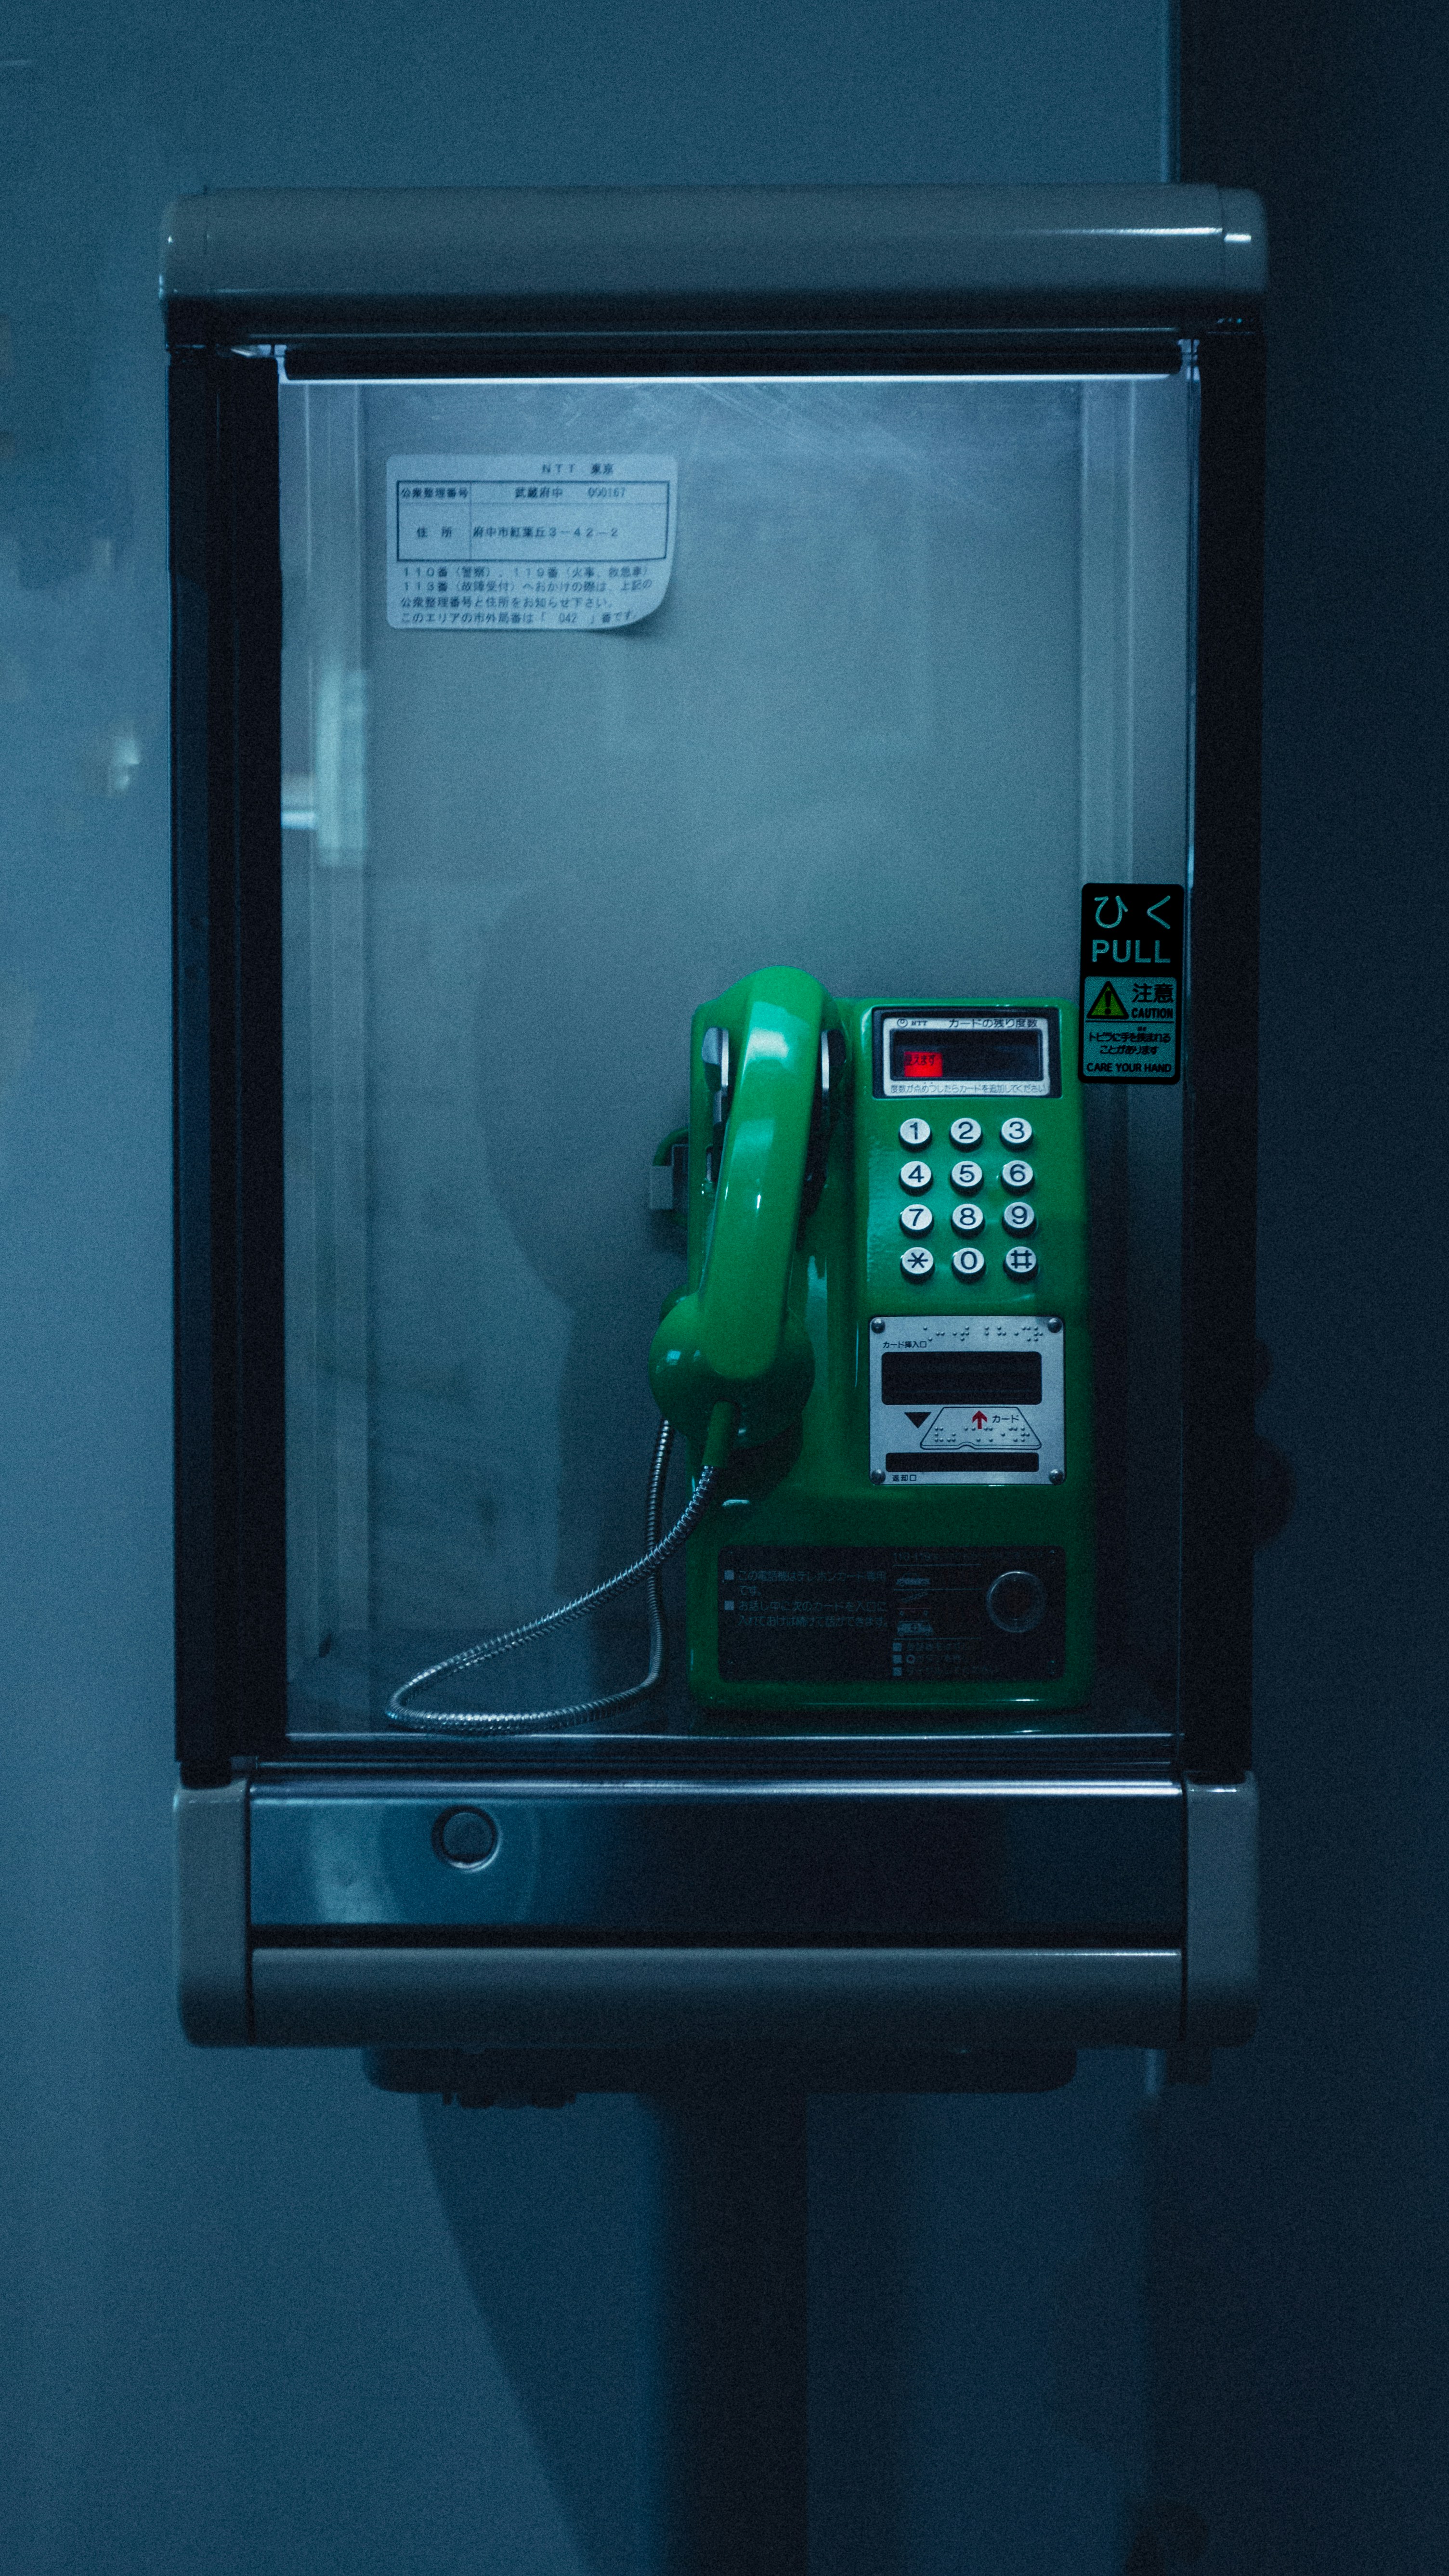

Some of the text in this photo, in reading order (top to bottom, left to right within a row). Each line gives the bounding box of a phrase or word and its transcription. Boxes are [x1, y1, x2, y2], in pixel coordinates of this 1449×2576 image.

[542, 463, 614, 474] NTT 東京
[1094, 895, 1171, 929] ひく
[1092, 939, 1171, 963] PULL
[1132, 983, 1174, 1003] 注意
[1131, 1008, 1174, 1019] CAUTION
[949, 1018, 1038, 1028] カードの残り度数
[1100, 1045, 1159, 1055] ことがあります
[1086, 1063, 1172, 1073] CARE YOUR HAND
[909, 1121, 1025, 1140] 1 2 3
[908, 1164, 1026, 1183] 4 5 6
[909, 1206, 1028, 1226] 7 8 9
[960, 1251, 978, 1270] 0
[992, 1415, 1020, 1423] カード
[892, 1474, 917, 1482] 返却口
